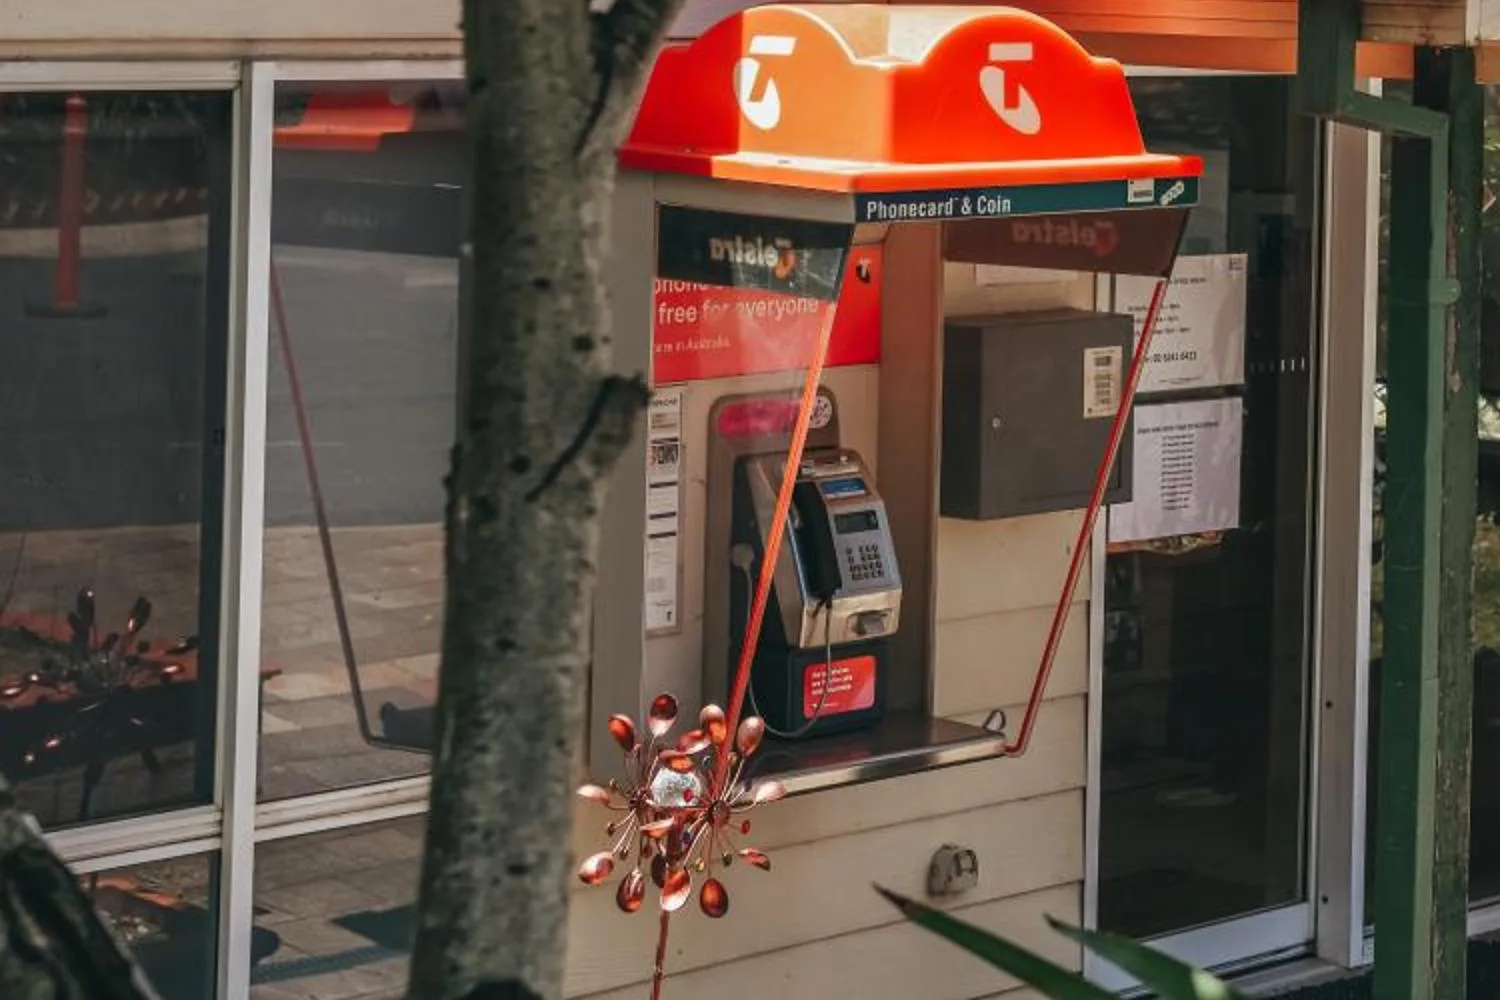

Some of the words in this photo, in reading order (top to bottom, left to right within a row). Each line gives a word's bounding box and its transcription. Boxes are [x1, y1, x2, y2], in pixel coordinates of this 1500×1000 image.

[866, 197, 954, 221] Phonecard
[961, 195, 972, 215] &
[977, 195, 1011, 214] Coin
[658, 301, 697, 325] free
[702, 299, 730, 321] for
[736, 297, 819, 321] everyone
